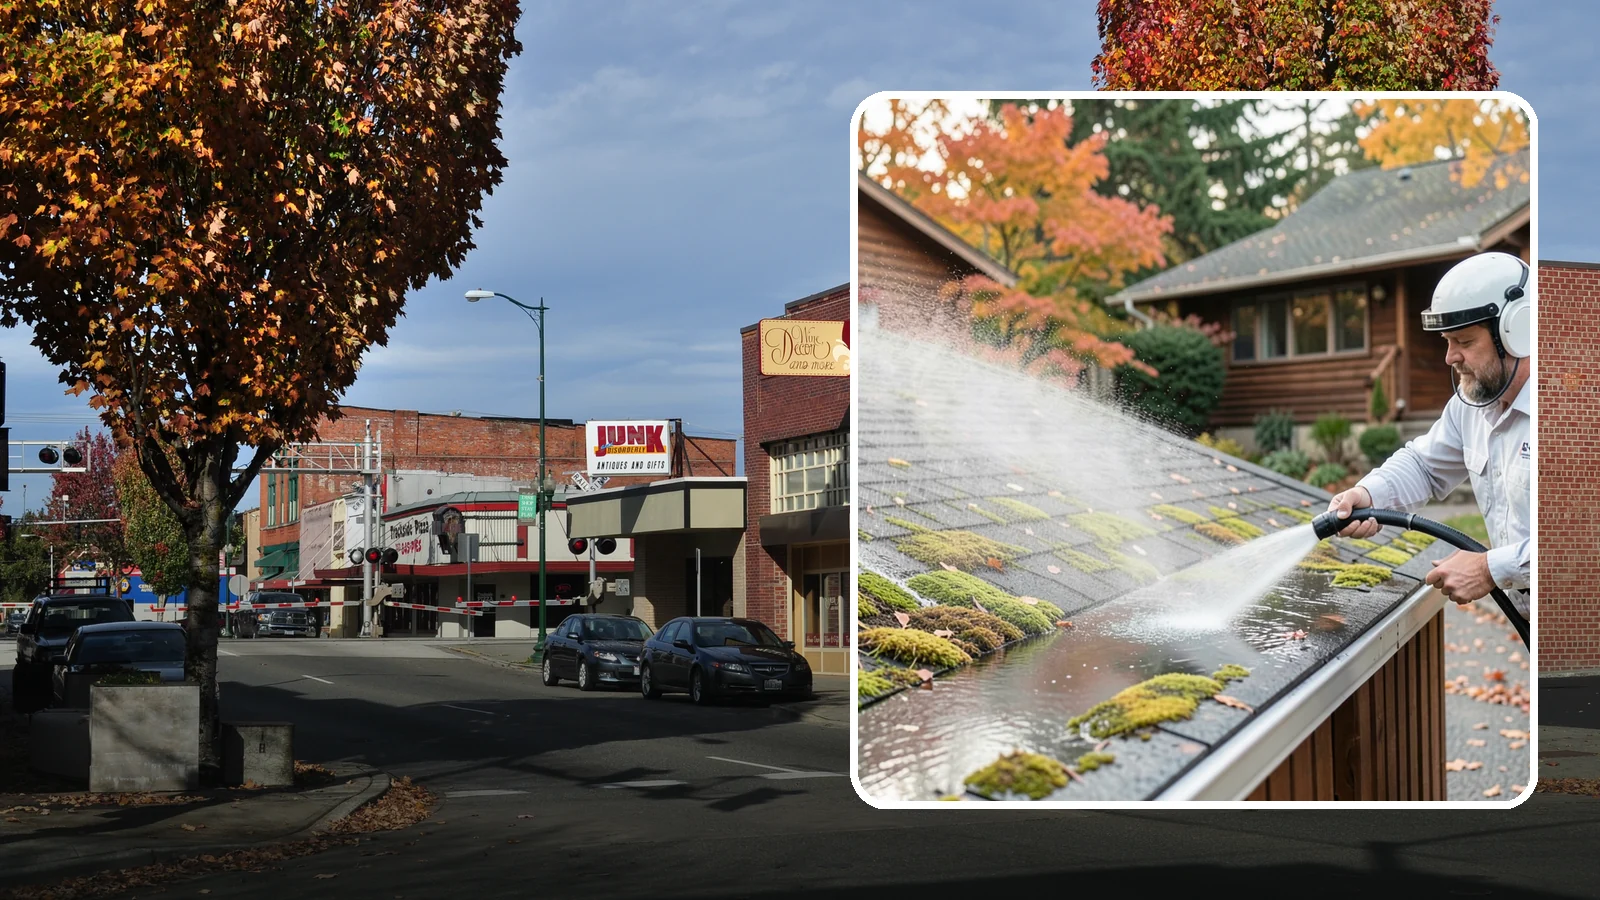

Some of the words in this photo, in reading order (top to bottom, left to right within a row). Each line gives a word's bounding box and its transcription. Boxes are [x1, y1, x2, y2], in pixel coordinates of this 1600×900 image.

[765, 328, 831, 365] Decor
[595, 425, 666, 457] JUNK
[607, 446, 646, 454] DISORDERLY
[597, 460, 628, 470] ANTIQUES
[631, 460, 644, 470] AND
[647, 460, 666, 470] GIFTS
[390, 521, 413, 539] Trackside
[415, 519, 429, 534] Pizza
